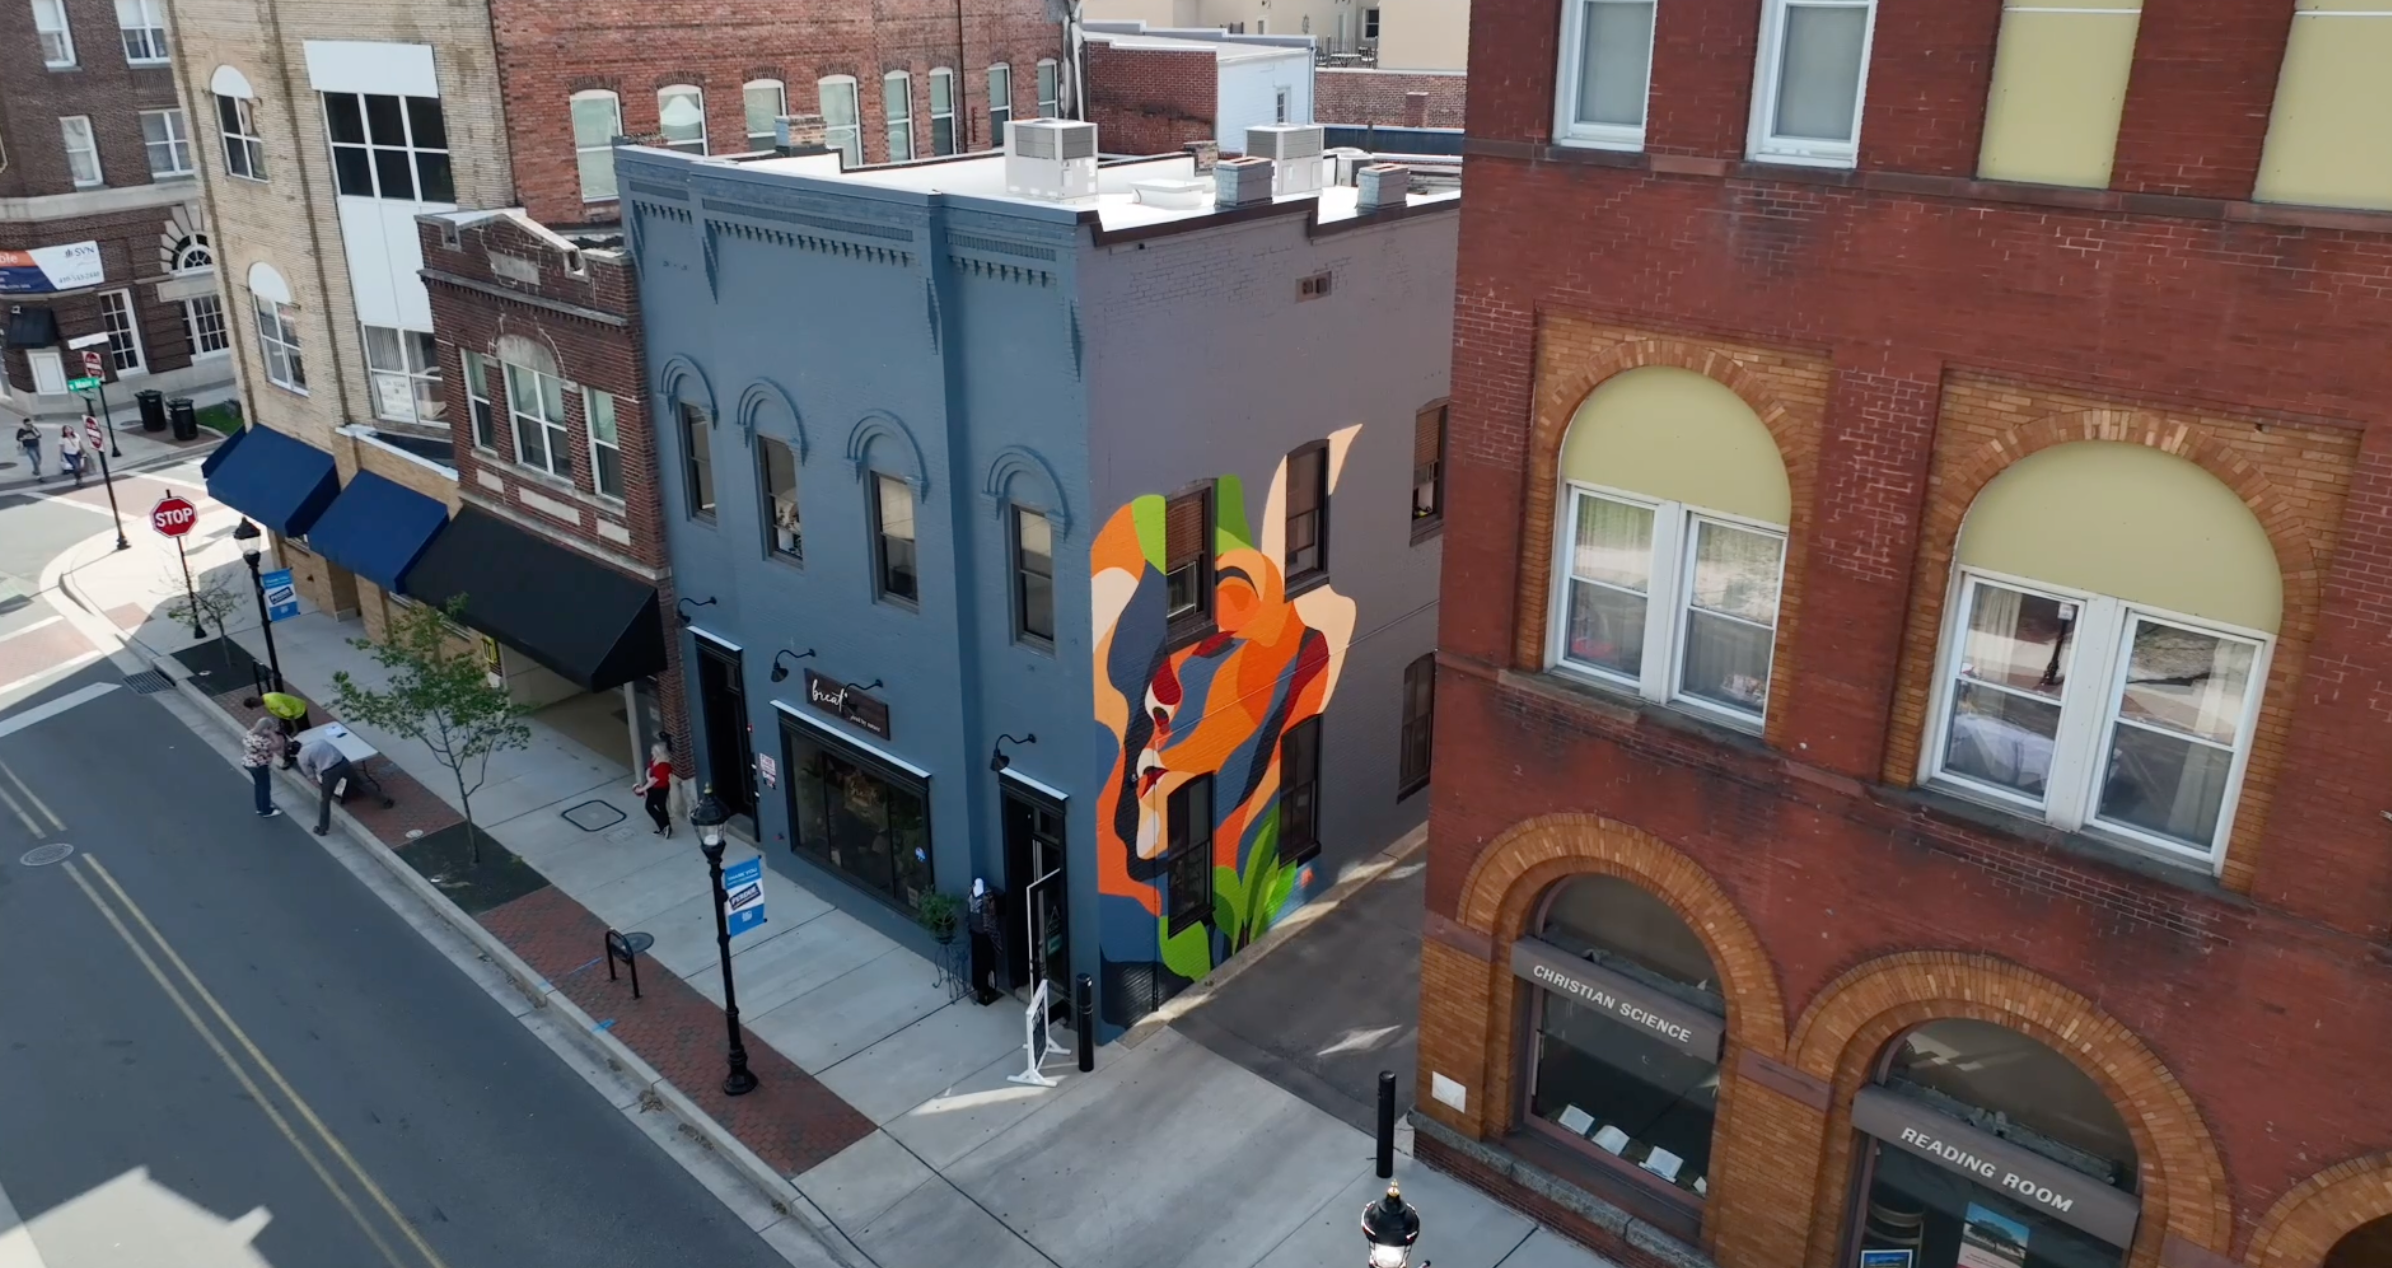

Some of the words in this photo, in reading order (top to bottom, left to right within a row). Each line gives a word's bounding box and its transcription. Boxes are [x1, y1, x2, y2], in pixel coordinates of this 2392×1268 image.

[75, 246, 95, 257] SVN
[155, 508, 193, 528] STOP
[1533, 965, 1616, 1009] CHRISTIAN
[1619, 1003, 1692, 1043] SCIENCE
[1901, 1127, 1997, 1178] READING
[2002, 1173, 2074, 1213] ROOM
